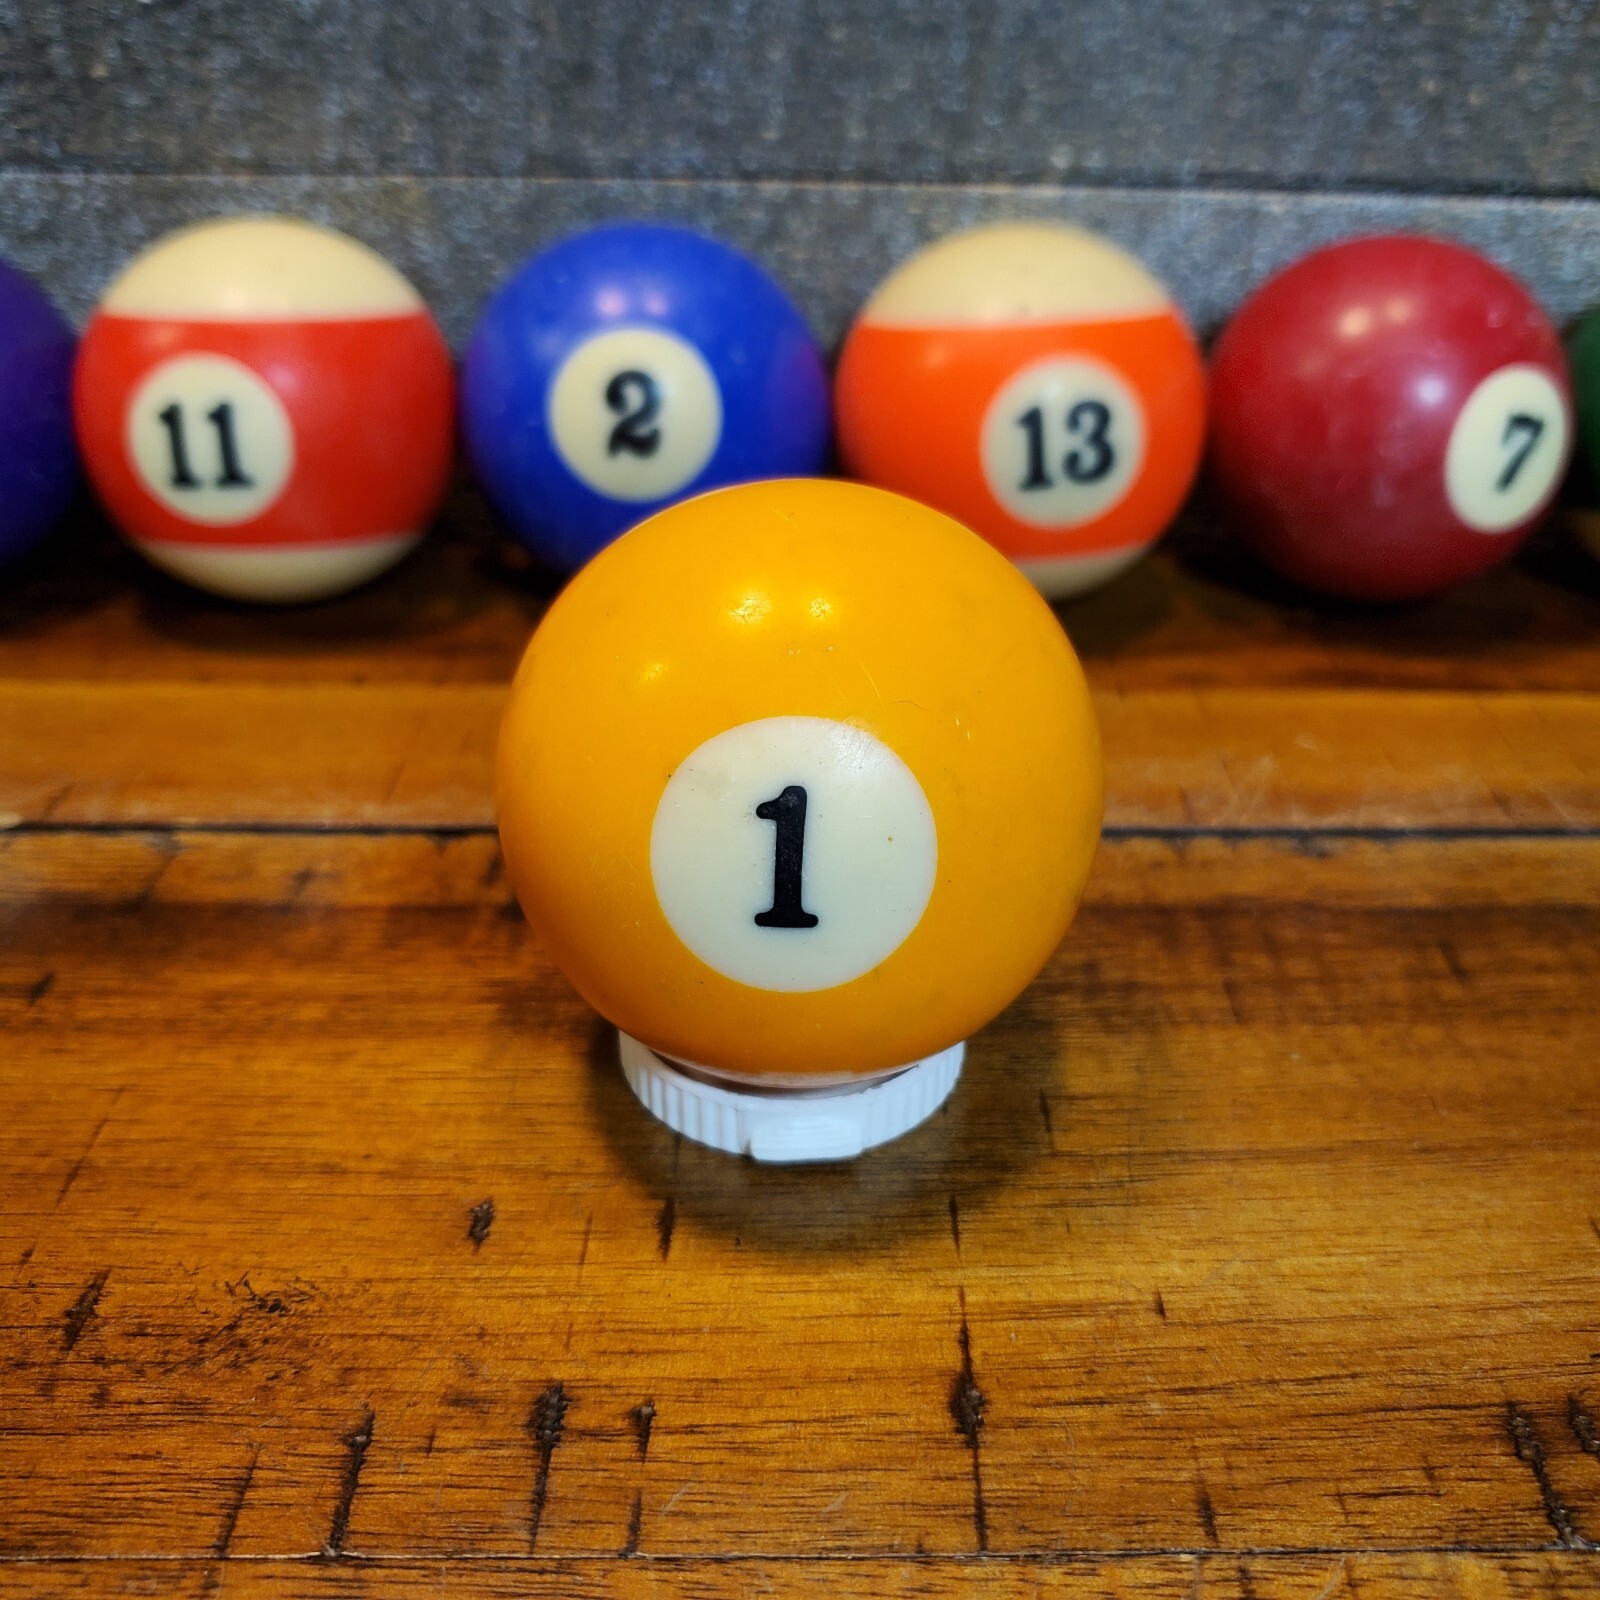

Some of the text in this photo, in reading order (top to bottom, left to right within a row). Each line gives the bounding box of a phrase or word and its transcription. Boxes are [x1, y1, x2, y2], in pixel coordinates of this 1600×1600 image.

[156, 402, 254, 492] 11
[604, 369, 662, 459] 2
[1016, 399, 1118, 493] 13
[1496, 412, 1546, 492] 7
[753, 784, 820, 930] 1
